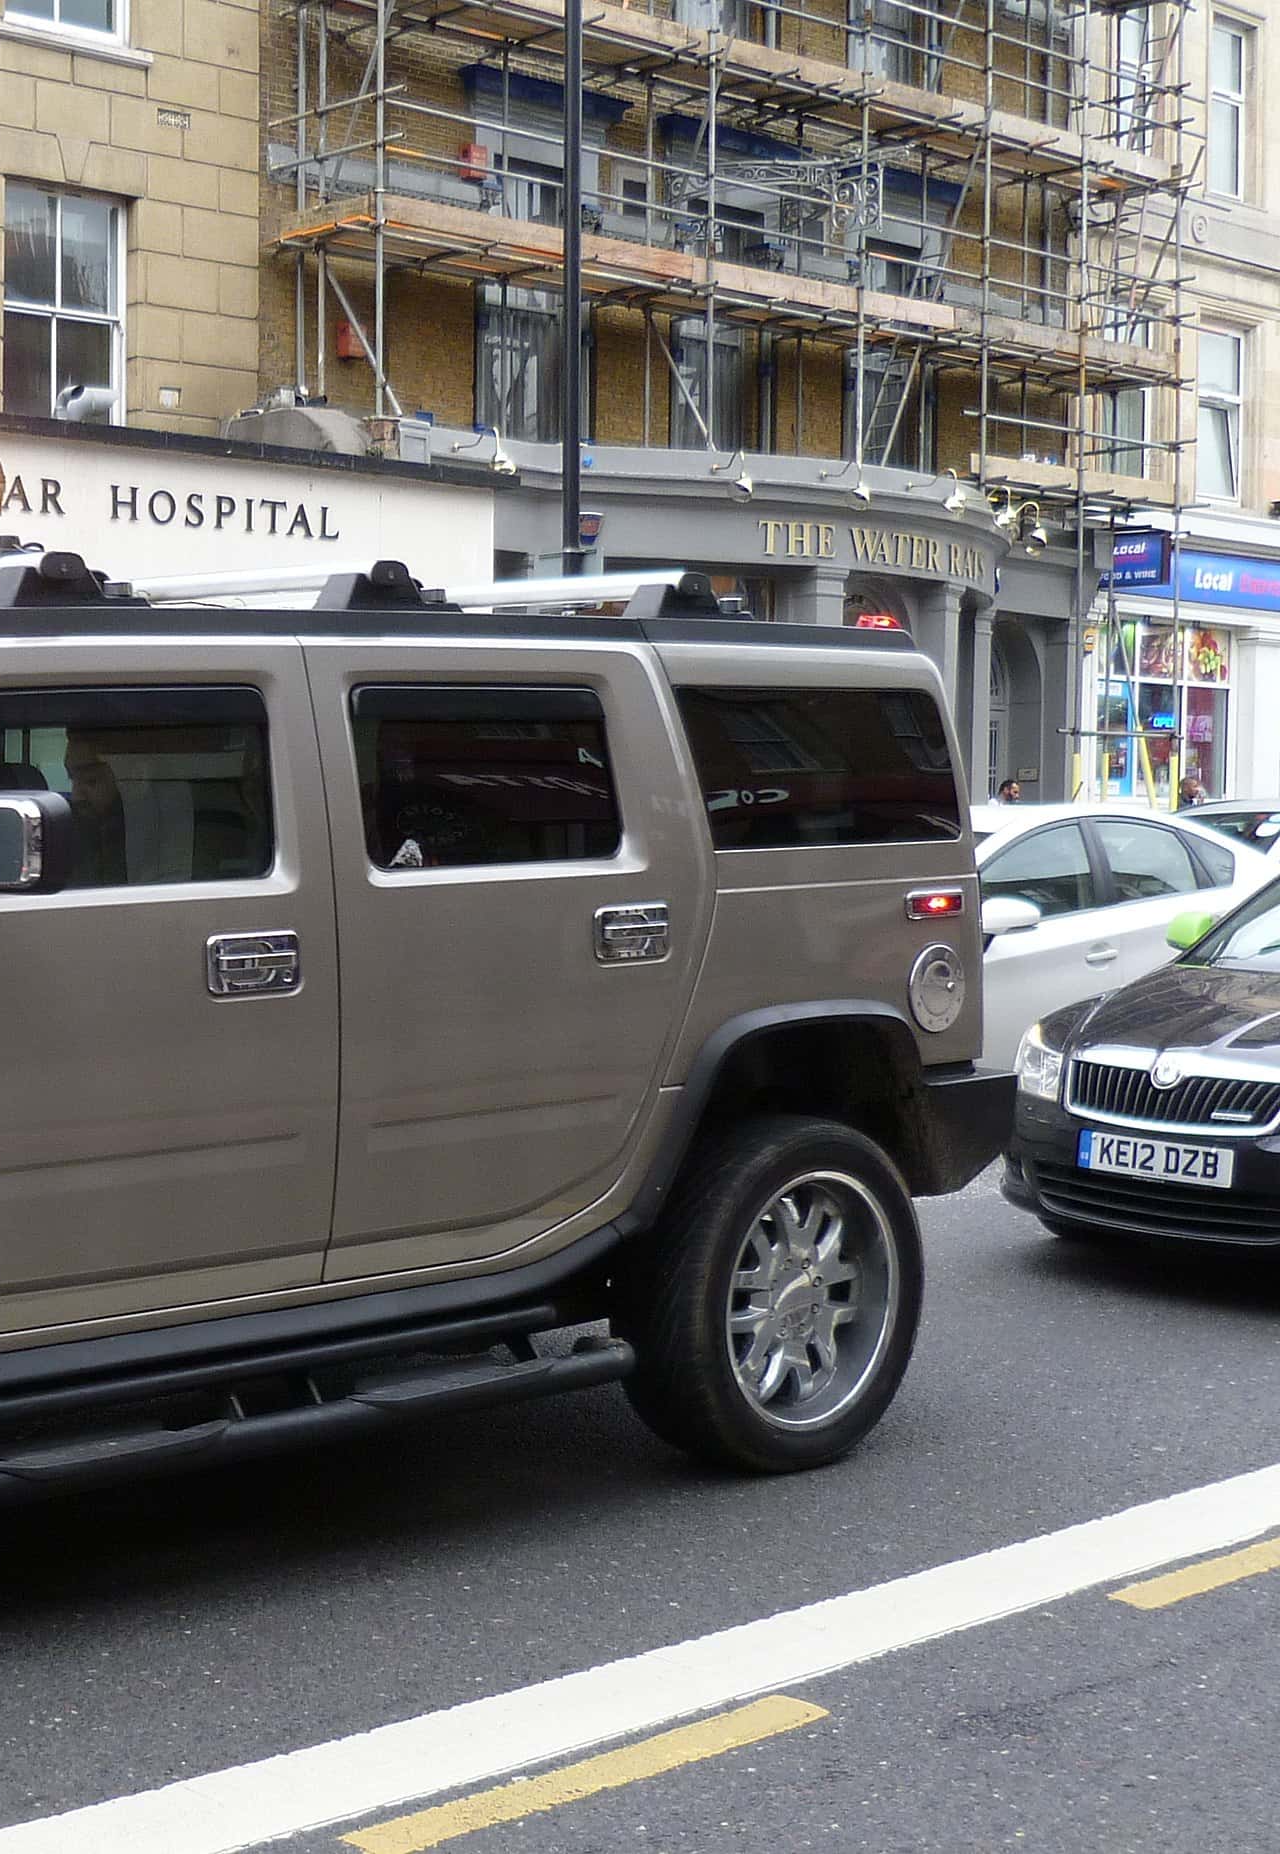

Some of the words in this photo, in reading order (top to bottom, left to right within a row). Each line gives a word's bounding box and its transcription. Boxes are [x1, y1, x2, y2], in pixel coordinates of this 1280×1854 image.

[2, 474, 67, 515] AR
[109, 484, 341, 541] HOSPITAL
[758, 519, 837, 559] THE
[849, 526, 941, 572] WATER
[1195, 567, 1232, 592] Local
[1098, 1136, 1156, 1172] KE12
[1163, 1146, 1219, 1180] DZB
